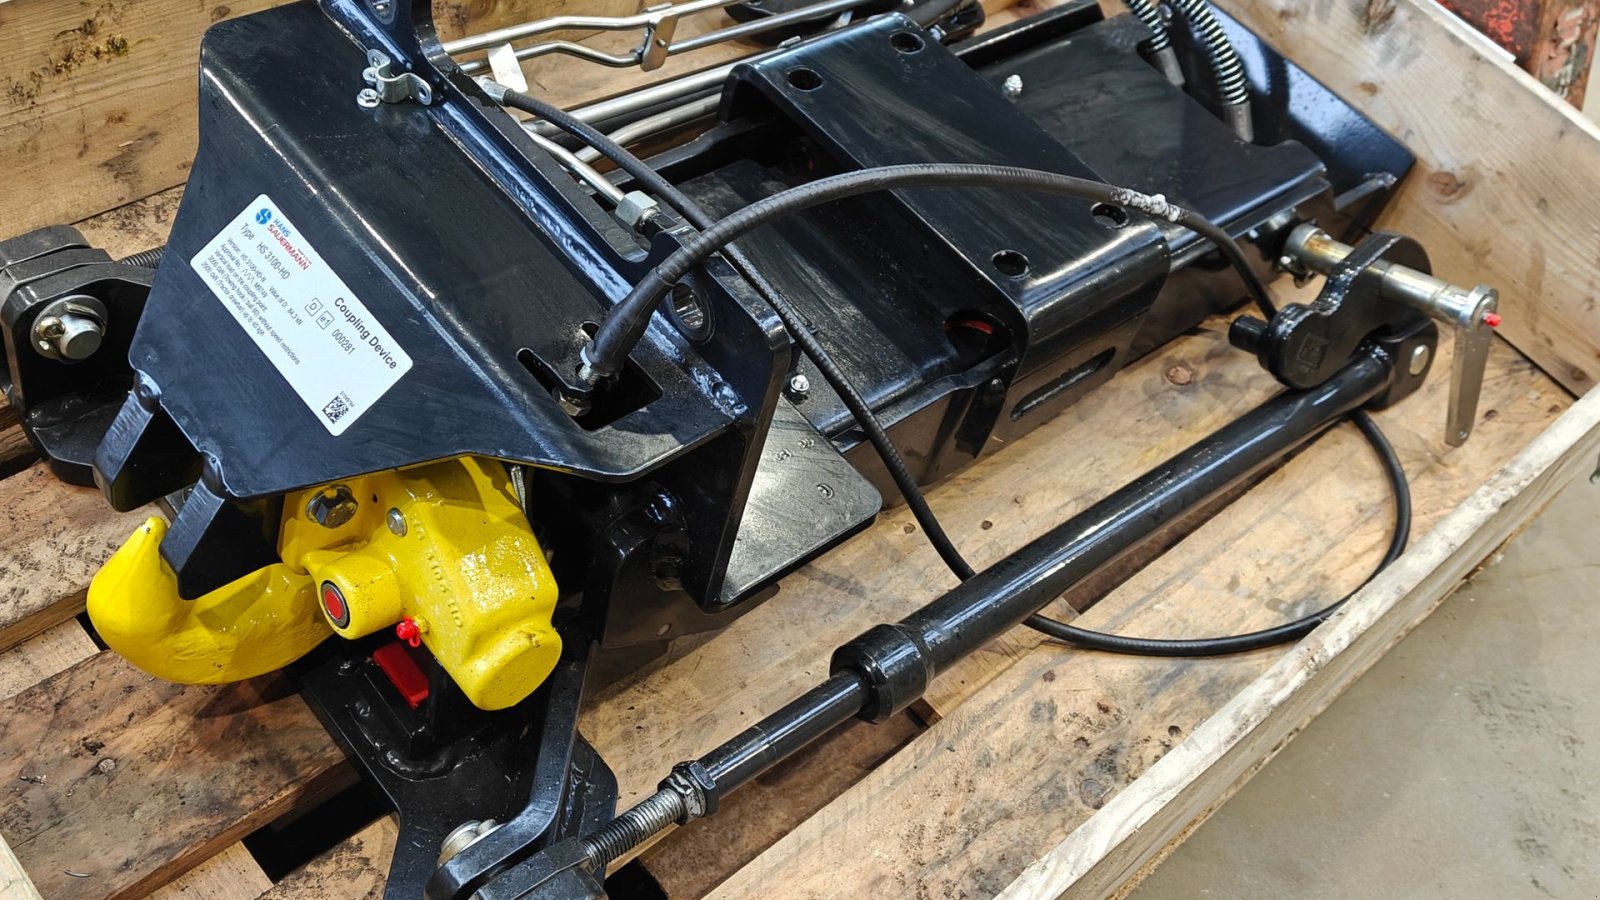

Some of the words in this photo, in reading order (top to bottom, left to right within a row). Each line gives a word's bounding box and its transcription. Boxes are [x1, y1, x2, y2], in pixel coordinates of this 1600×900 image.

[238, 222, 256, 242] Type
[255, 241, 269, 255] HS
[263, 250, 291, 280] 3100-HD
[266, 223, 309, 271] SAUERMANN
[272, 217, 290, 237] HANS
[330, 327, 356, 355] 000281
[331, 295, 372, 341] Coupling
[367, 334, 399, 370] Device
